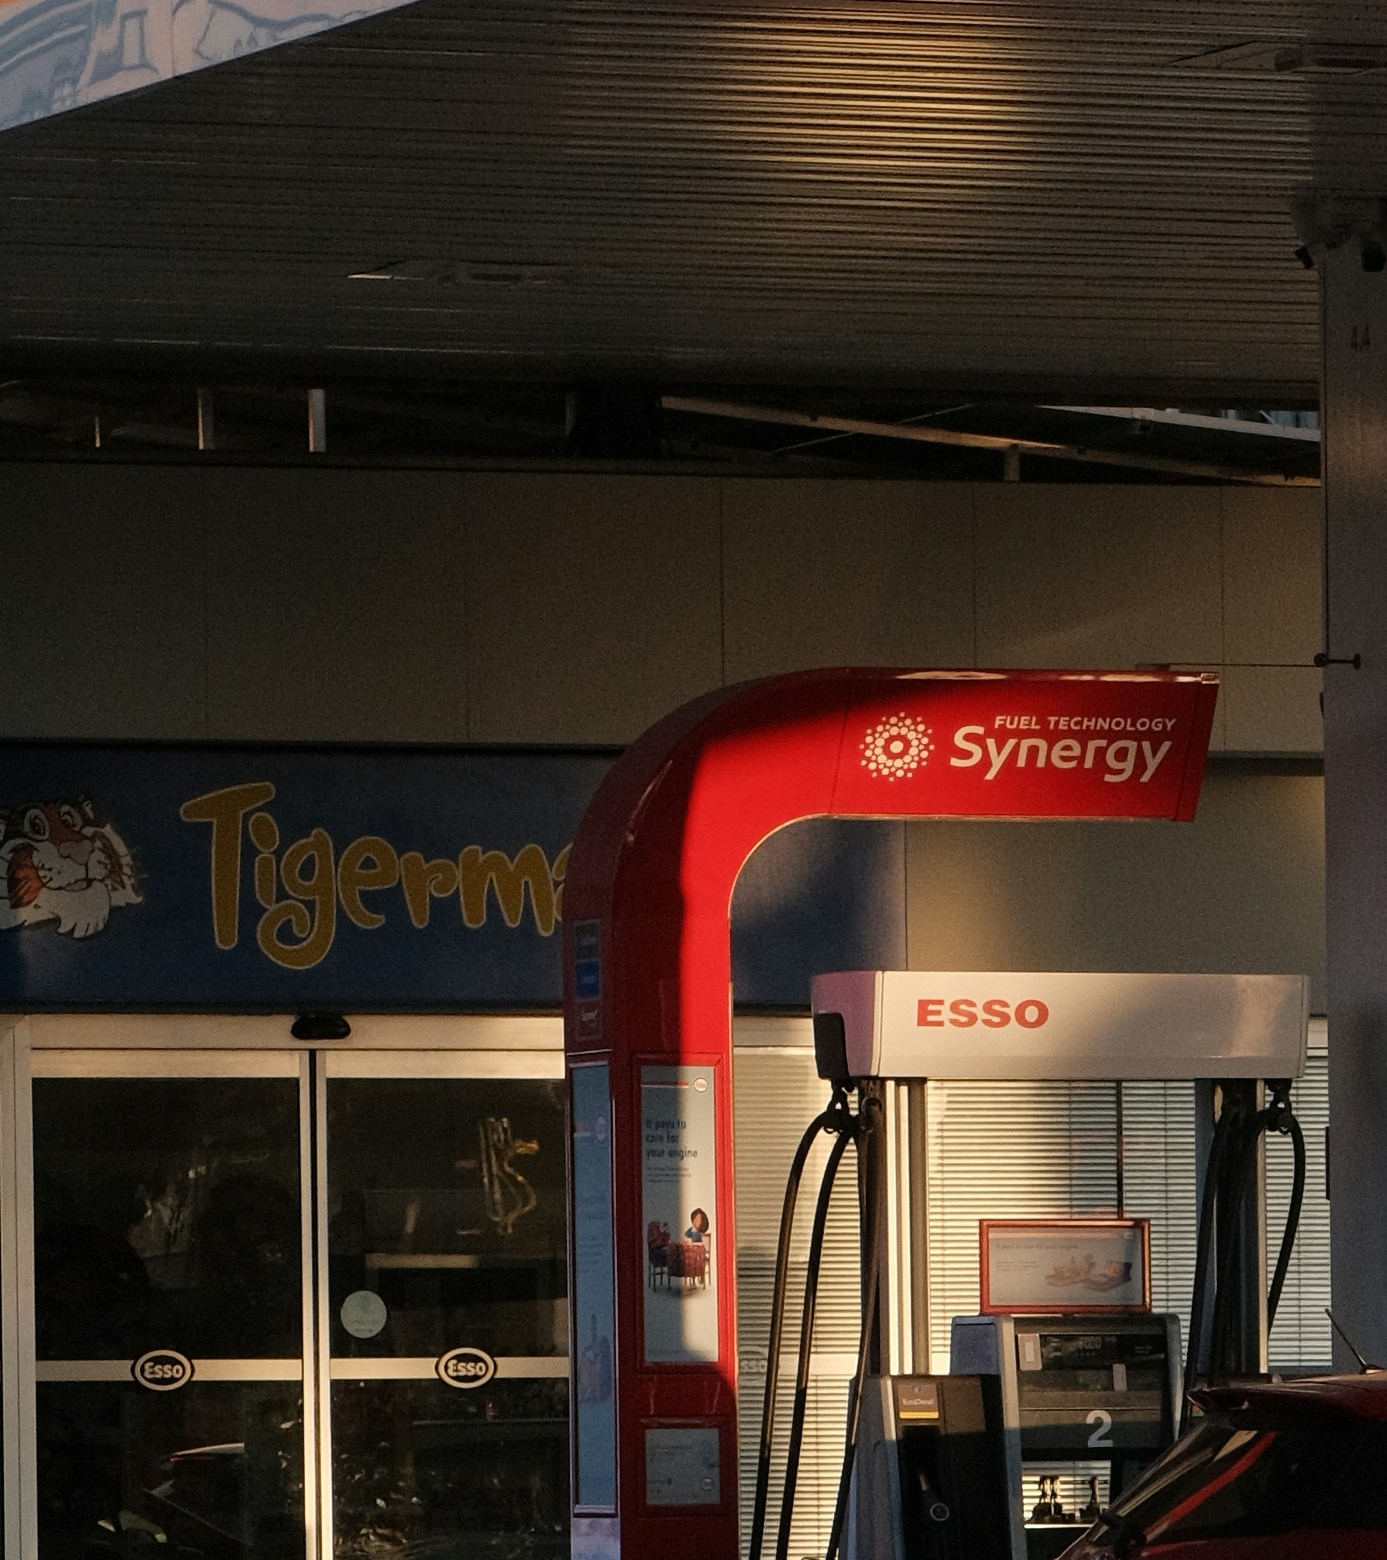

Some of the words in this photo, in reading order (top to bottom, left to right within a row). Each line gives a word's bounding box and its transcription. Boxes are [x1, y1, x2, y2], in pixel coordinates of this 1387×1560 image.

[994, 715, 1041, 730] FUEL
[1048, 716, 1177, 732] TECHNOLOGY
[950, 725, 1172, 783] Synergy
[917, 999, 1050, 1029] ESSO
[143, 1359, 184, 1379] Esso
[446, 1358, 487, 1377] Esso
[1085, 1409, 1114, 1449] 2
